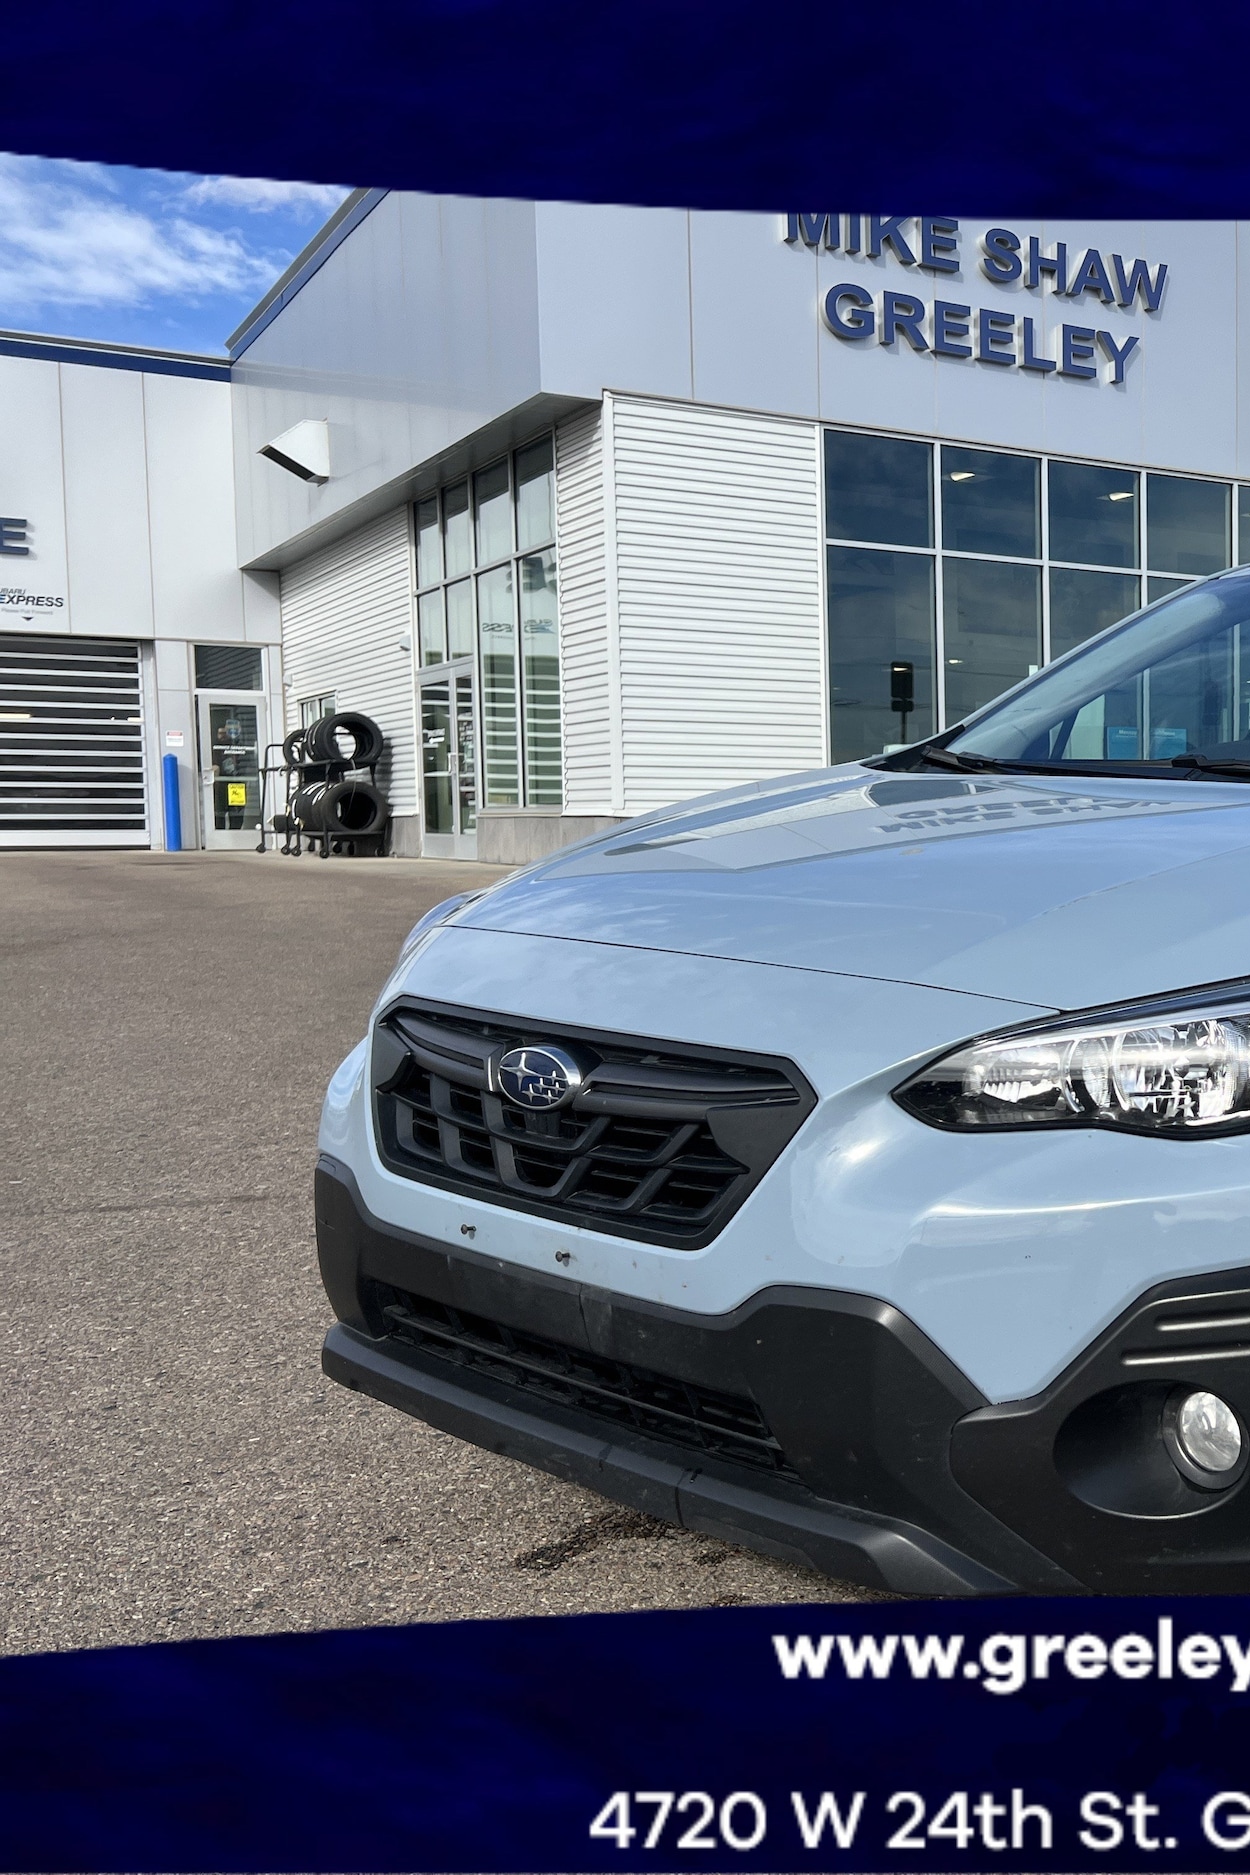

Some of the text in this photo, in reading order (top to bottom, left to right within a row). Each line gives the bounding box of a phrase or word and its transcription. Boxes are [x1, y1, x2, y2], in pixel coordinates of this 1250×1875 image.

[785, 213, 1169, 312] MIKE SHAW
[822, 283, 1140, 383] GREELEY
